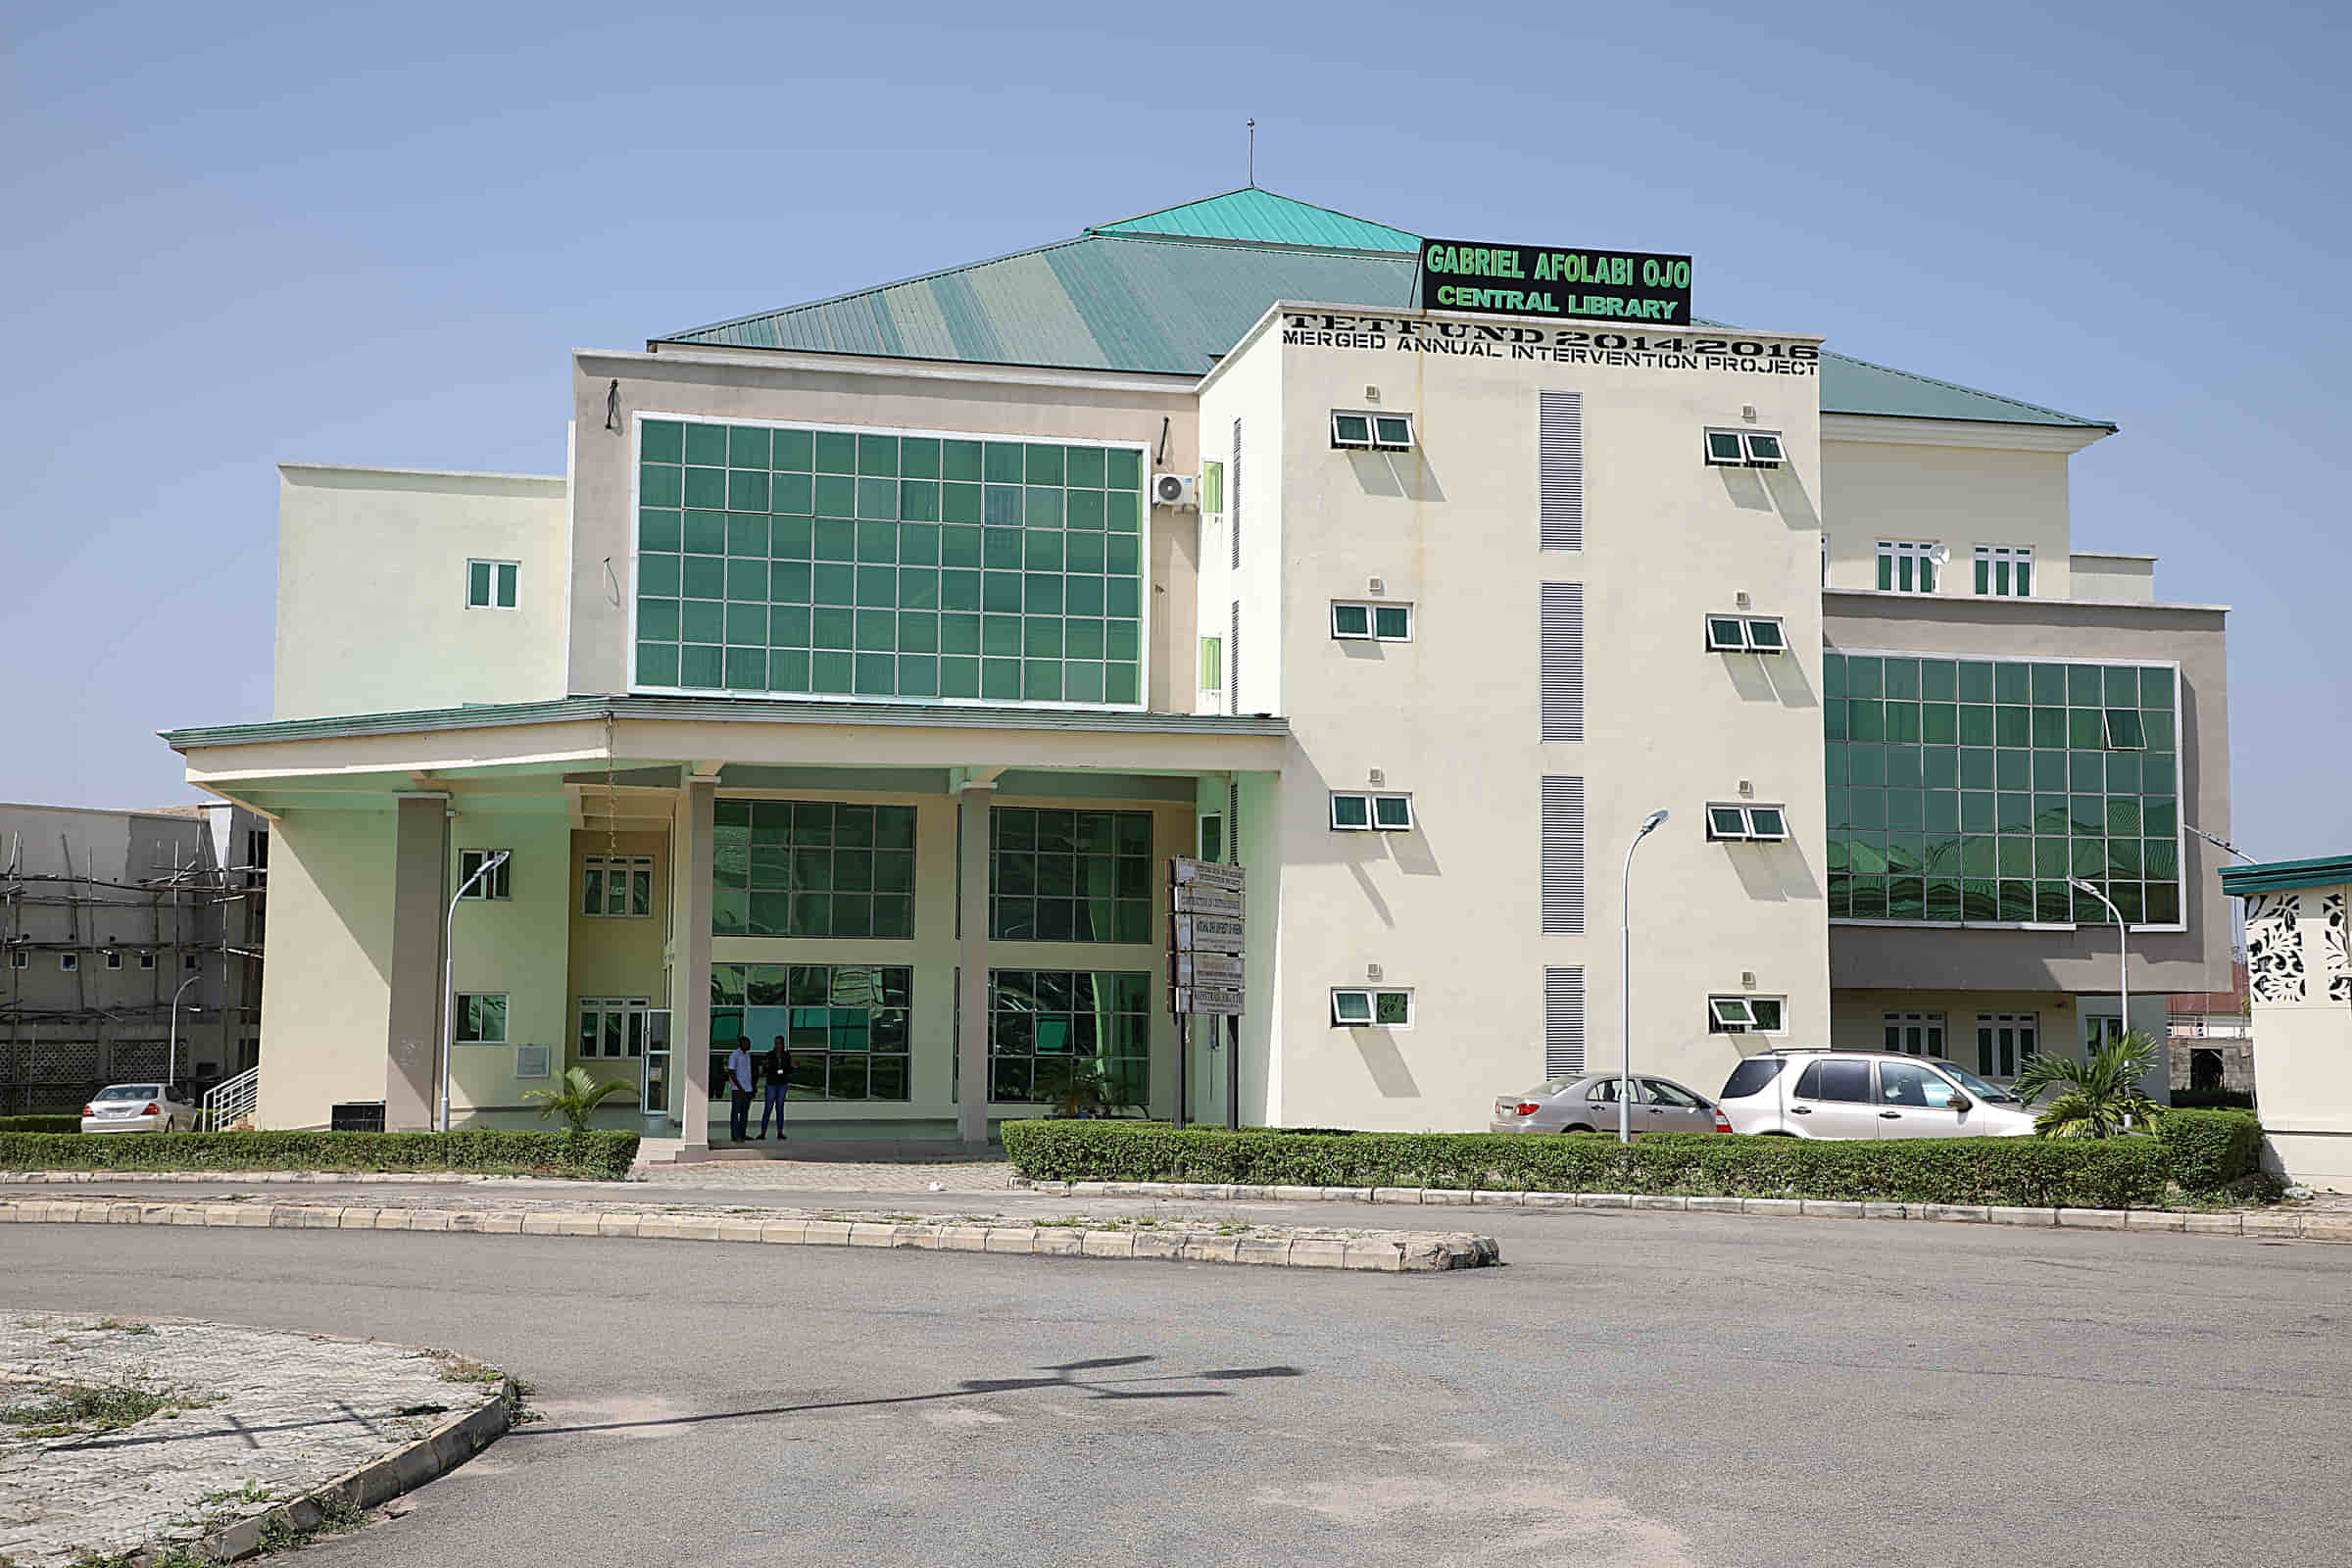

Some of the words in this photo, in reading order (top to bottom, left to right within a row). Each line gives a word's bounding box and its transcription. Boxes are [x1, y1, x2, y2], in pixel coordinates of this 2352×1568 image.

[1427, 245, 1525, 279] GABRIEL
[1534, 253, 1634, 286] AFOLABI
[1642, 260, 1690, 289] OJO
[1438, 285, 1560, 313] CENTRAL
[1568, 294, 1679, 319] LIBRARY
[1283, 313, 1544, 343] TETFUND
[1283, 330, 1386, 349] MERGED
[1396, 337, 1502, 358] ANNUAL
[1512, 345, 1697, 369] INTERVENTION
[1706, 357, 1819, 375] PROJECT
